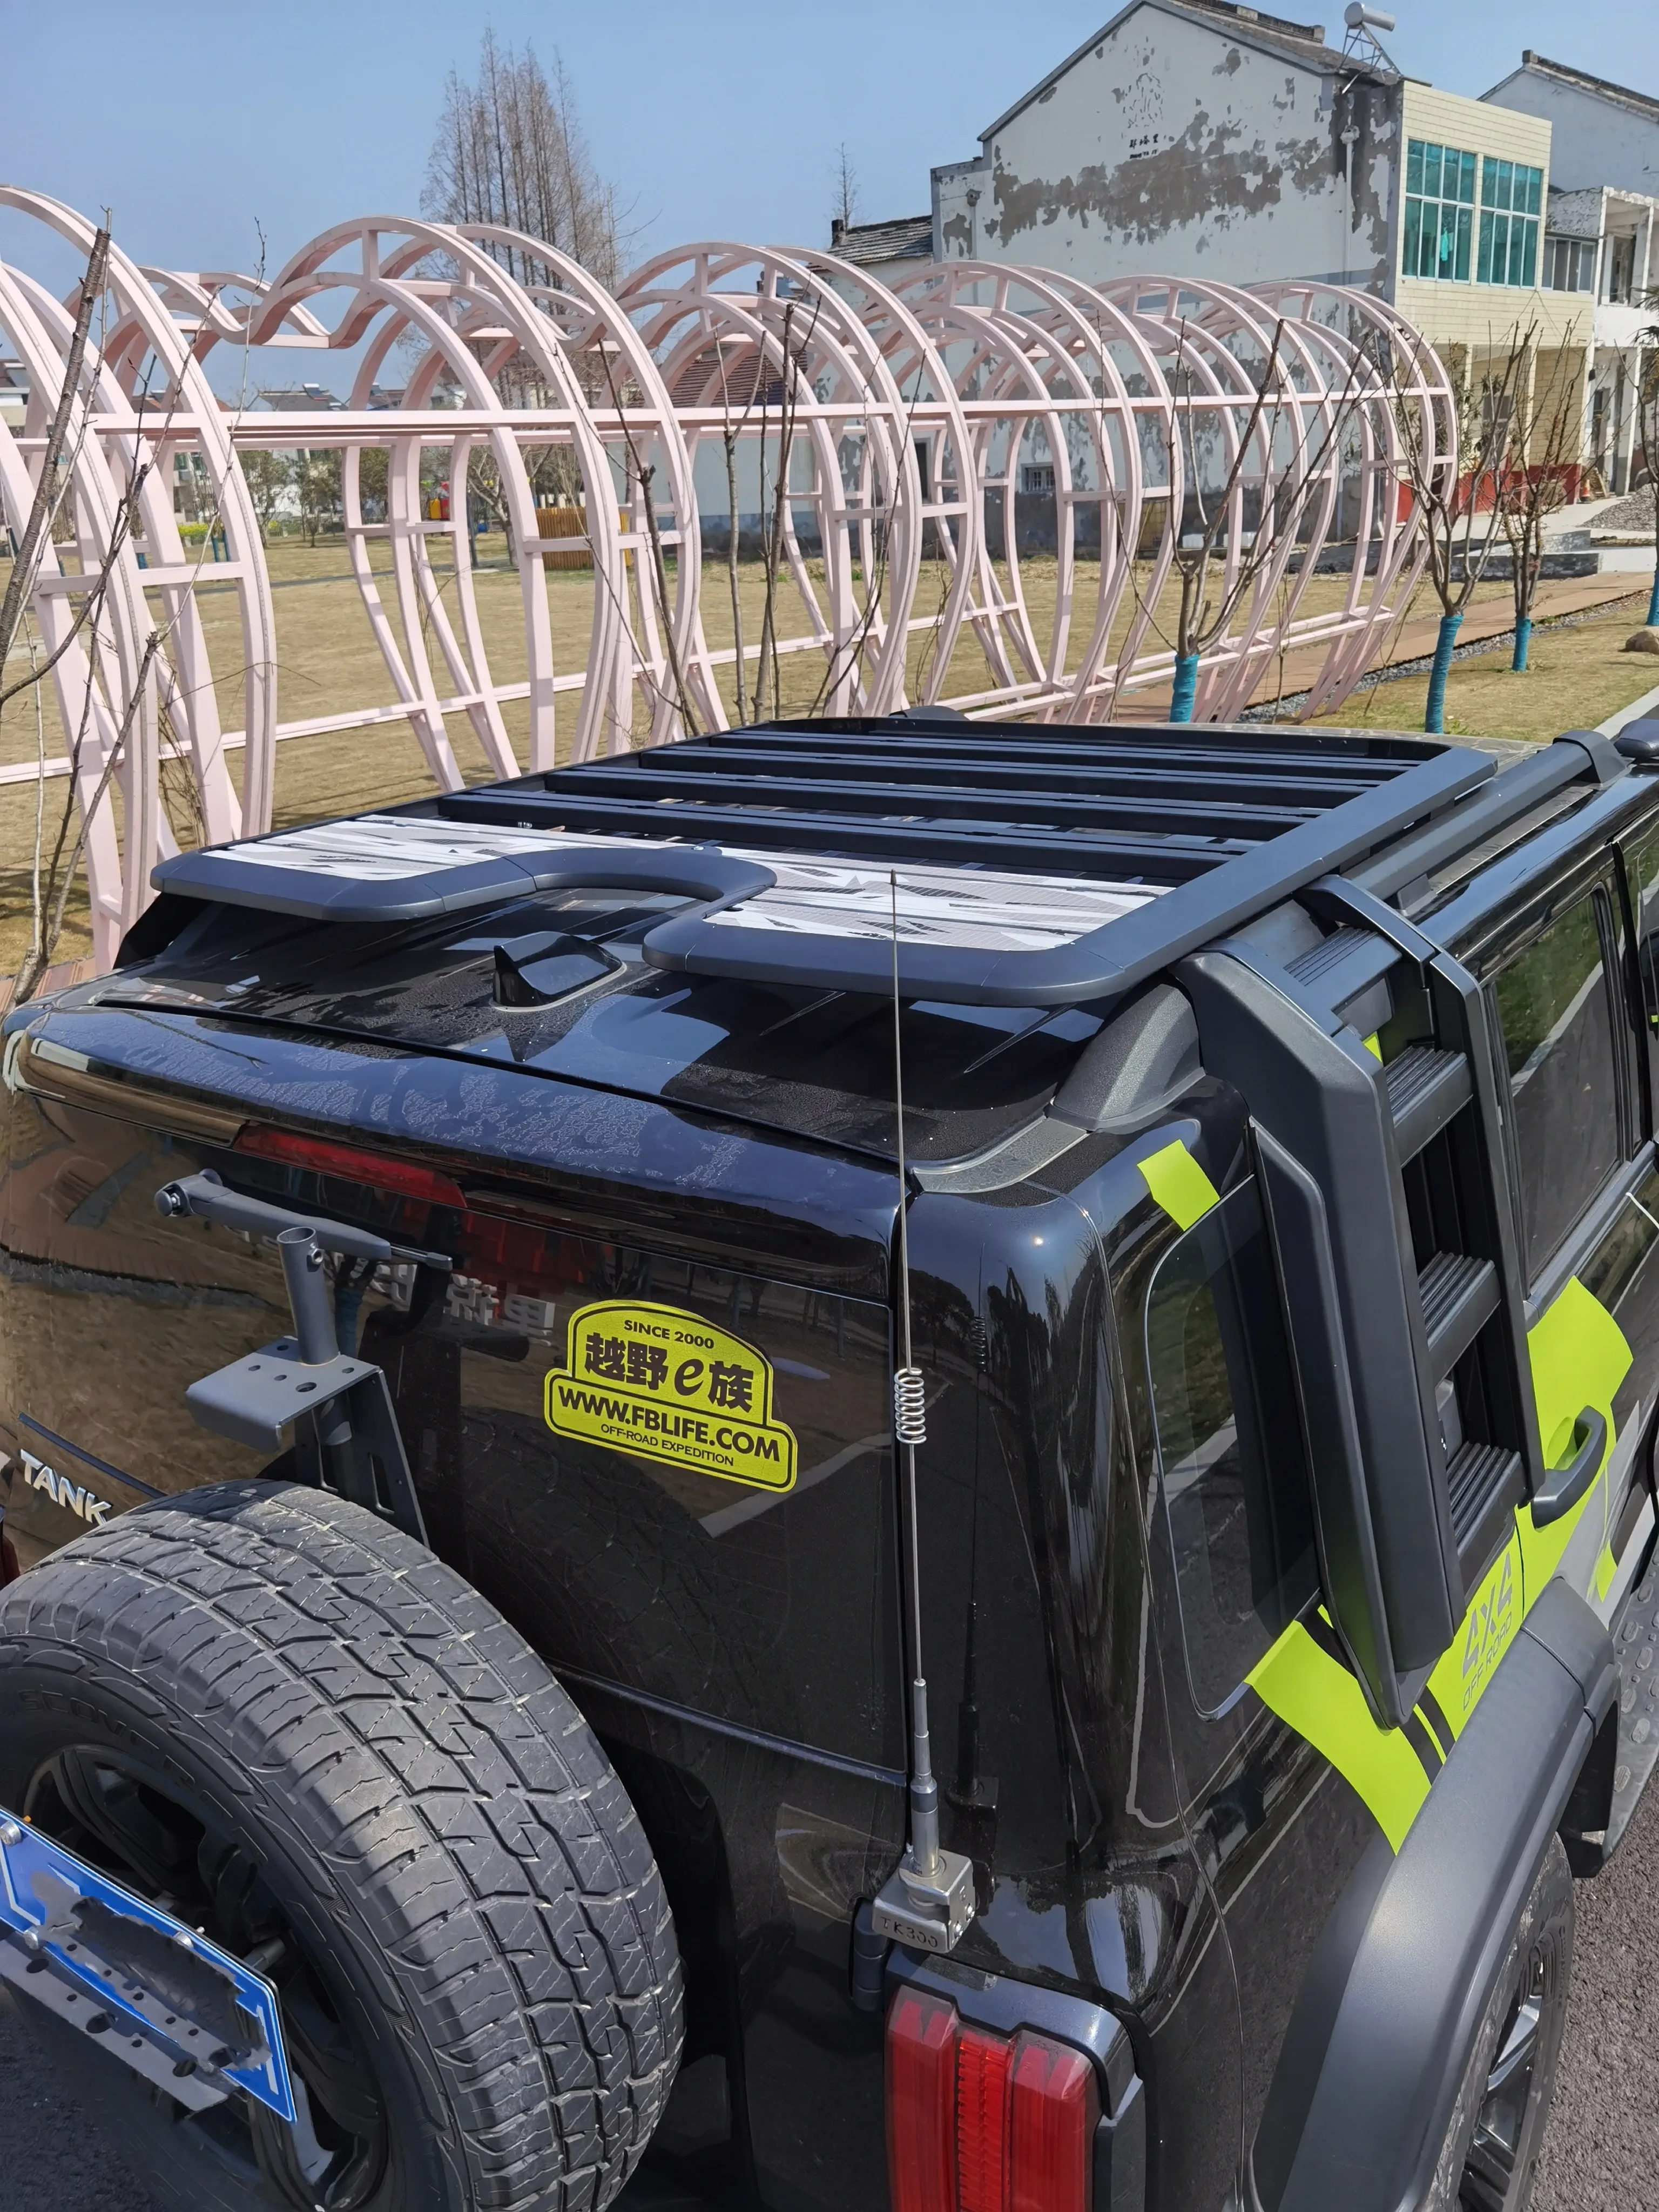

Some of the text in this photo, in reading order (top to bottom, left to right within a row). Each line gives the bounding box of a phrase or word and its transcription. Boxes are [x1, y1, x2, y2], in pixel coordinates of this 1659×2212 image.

[624, 1319, 714, 1350] SINCE 2000
[558, 1385, 780, 1462] WWW.FBLIFE.COM
[601, 1424, 734, 1466] OFF-ROAD EXPEDITION
[21, 1449, 112, 1526] TANK
[1464, 1611, 1512, 1711] OFF ROAD
